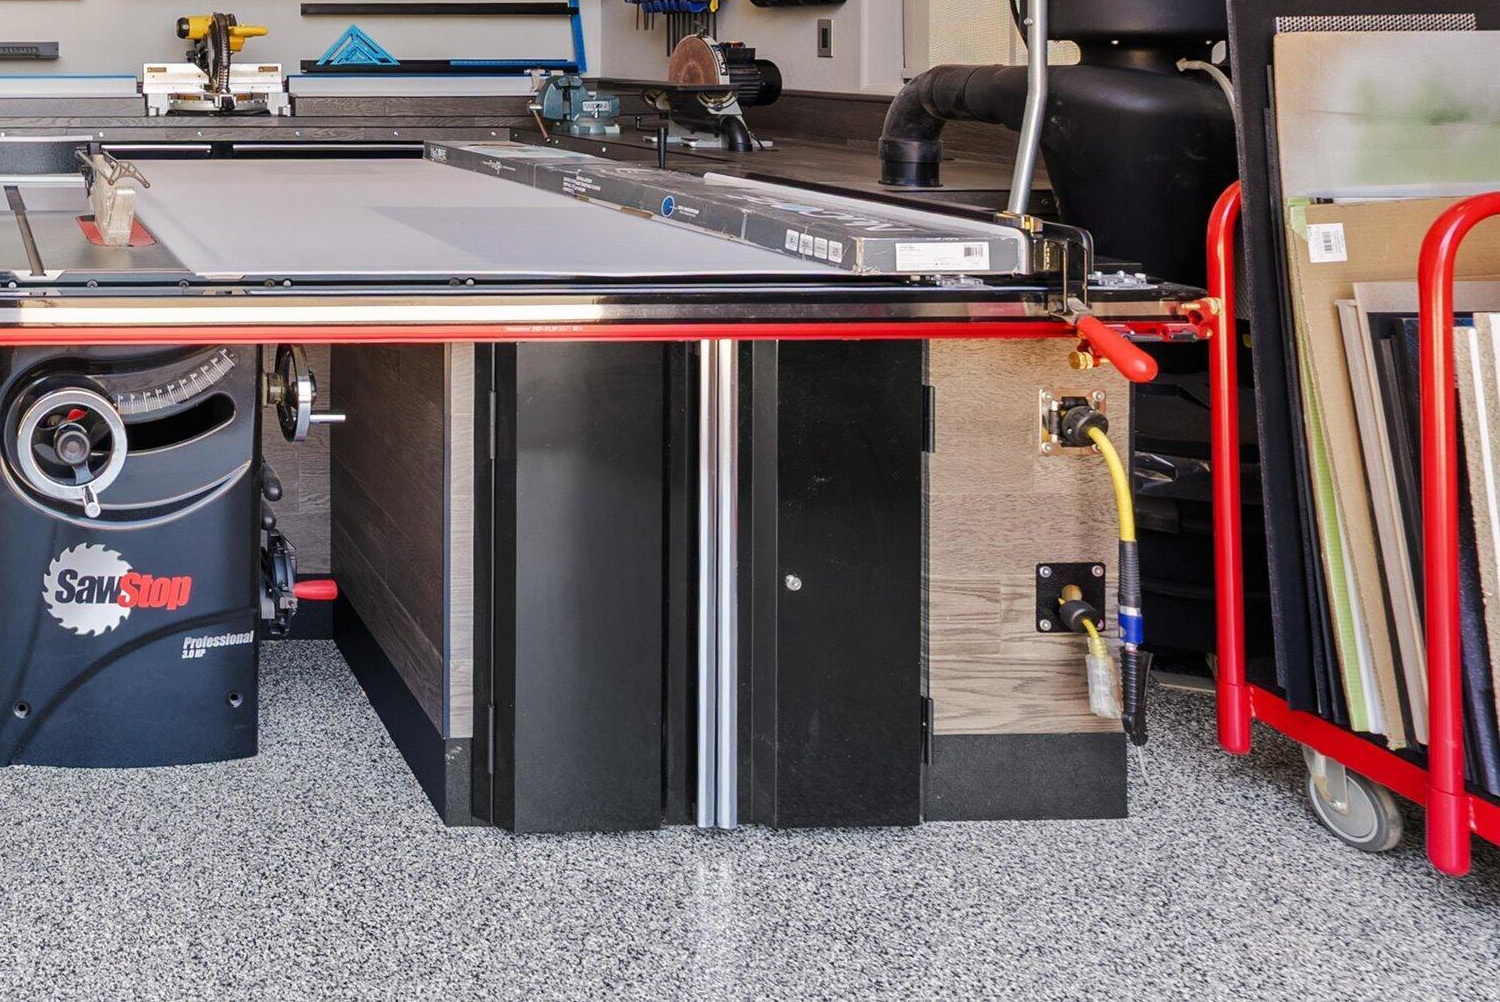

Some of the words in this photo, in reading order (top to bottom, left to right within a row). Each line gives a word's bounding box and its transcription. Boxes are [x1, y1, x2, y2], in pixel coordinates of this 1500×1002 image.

[54, 569, 192, 610] SawStop
[183, 630, 255, 650] Professional
[182, 650, 194, 659] 3.0
[194, 649, 206, 658] HP
